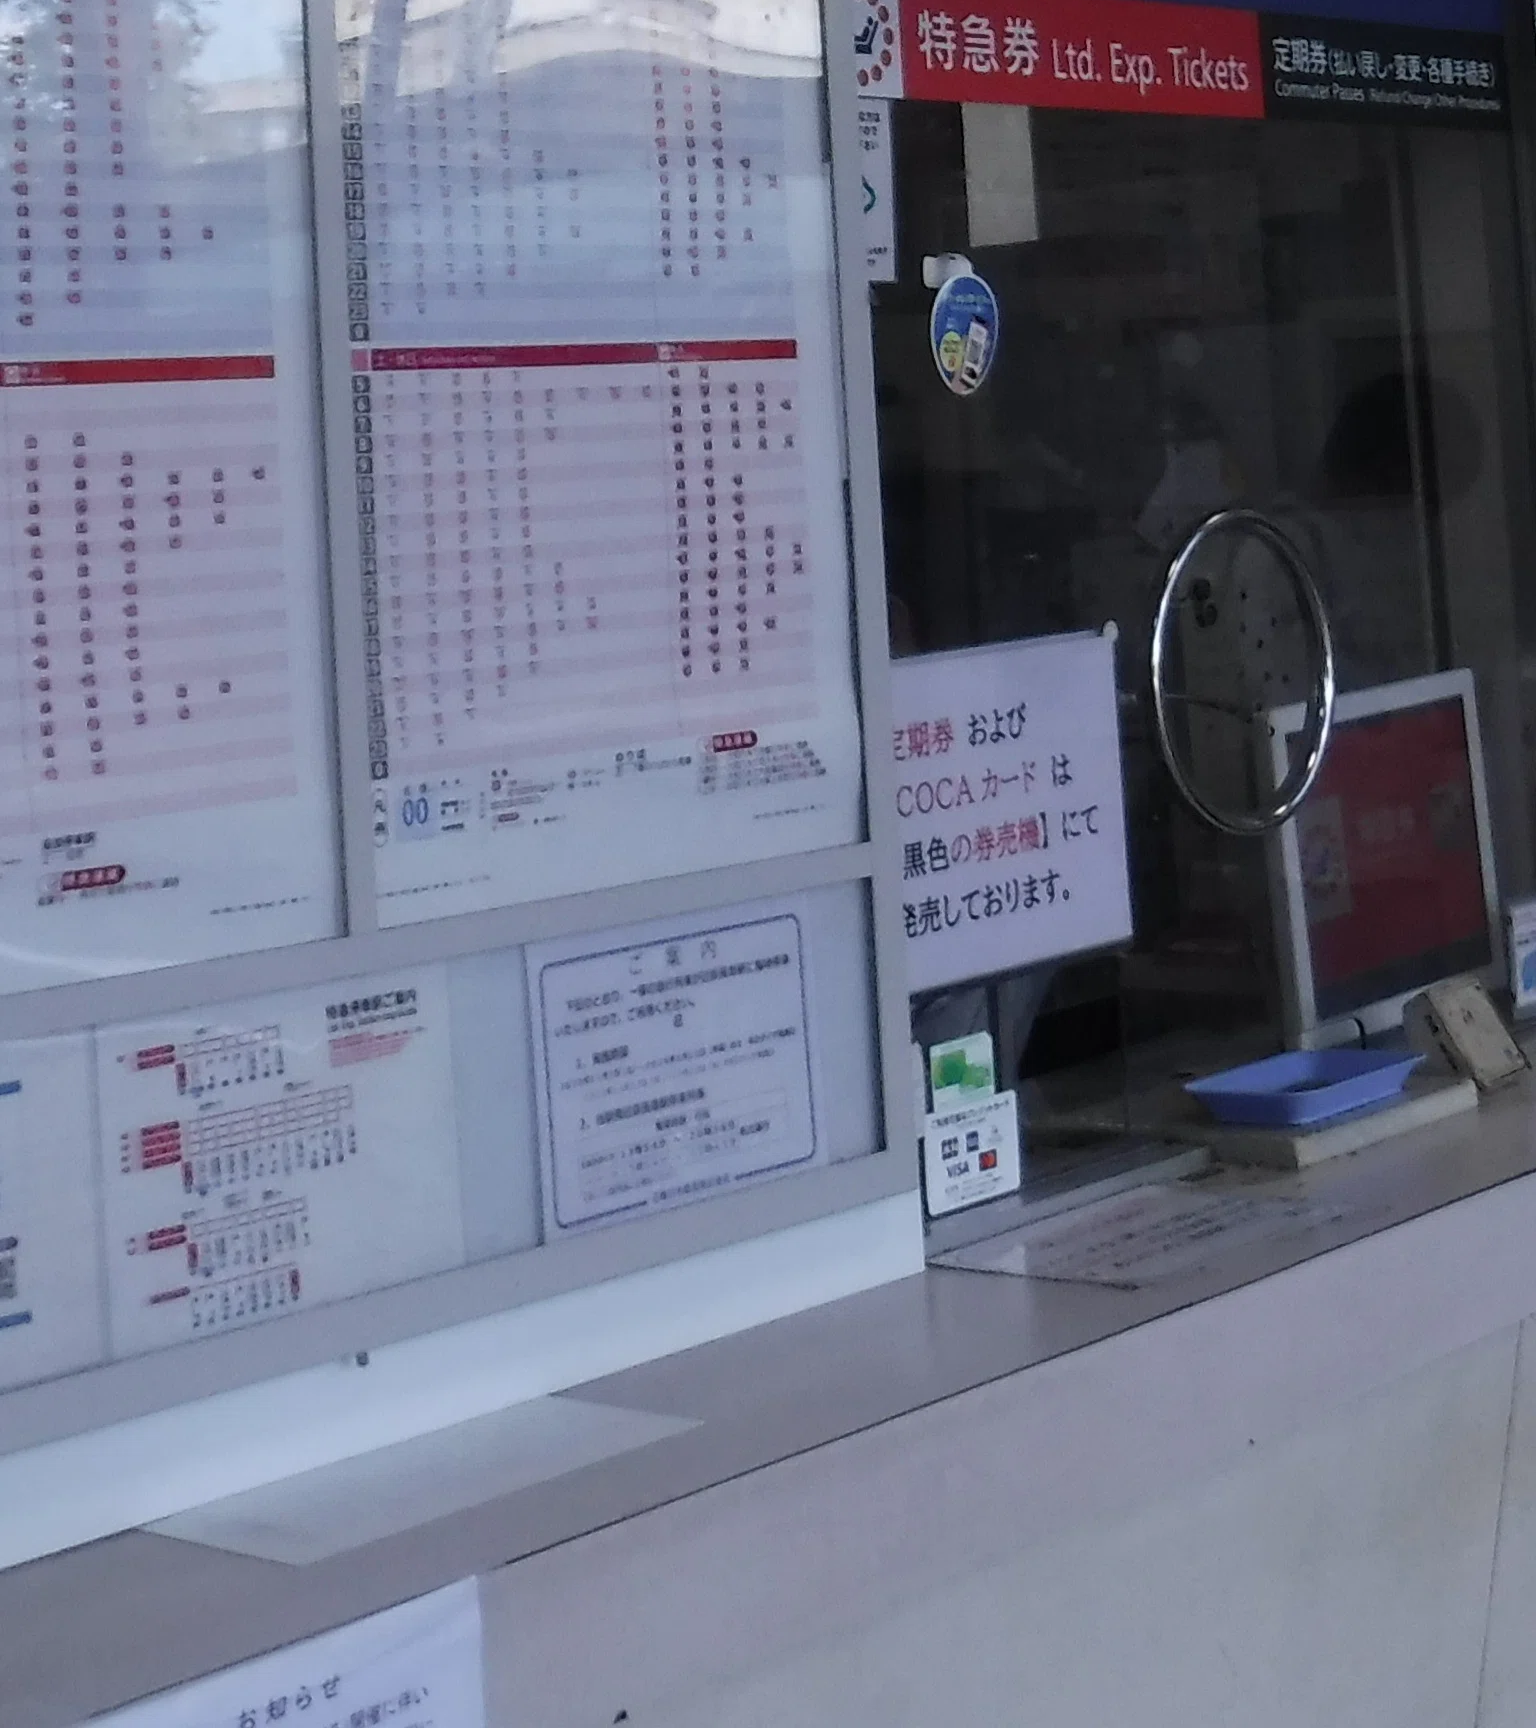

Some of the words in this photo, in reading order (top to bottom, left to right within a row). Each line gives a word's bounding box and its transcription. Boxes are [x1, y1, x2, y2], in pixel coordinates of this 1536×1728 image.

[917, 9, 1041, 77] 特急券
[1051, 36, 1102, 83] Ltd.
[1108, 42, 1163, 96] Exp.
[1166, 45, 1250, 92] Tickets
[967, 702, 1027, 748] および
[980, 760, 1036, 803] カード
[1050, 752, 1073, 789] は
[1061, 804, 1099, 842] にて
[238, 1673, 341, 1728] お知らせ
